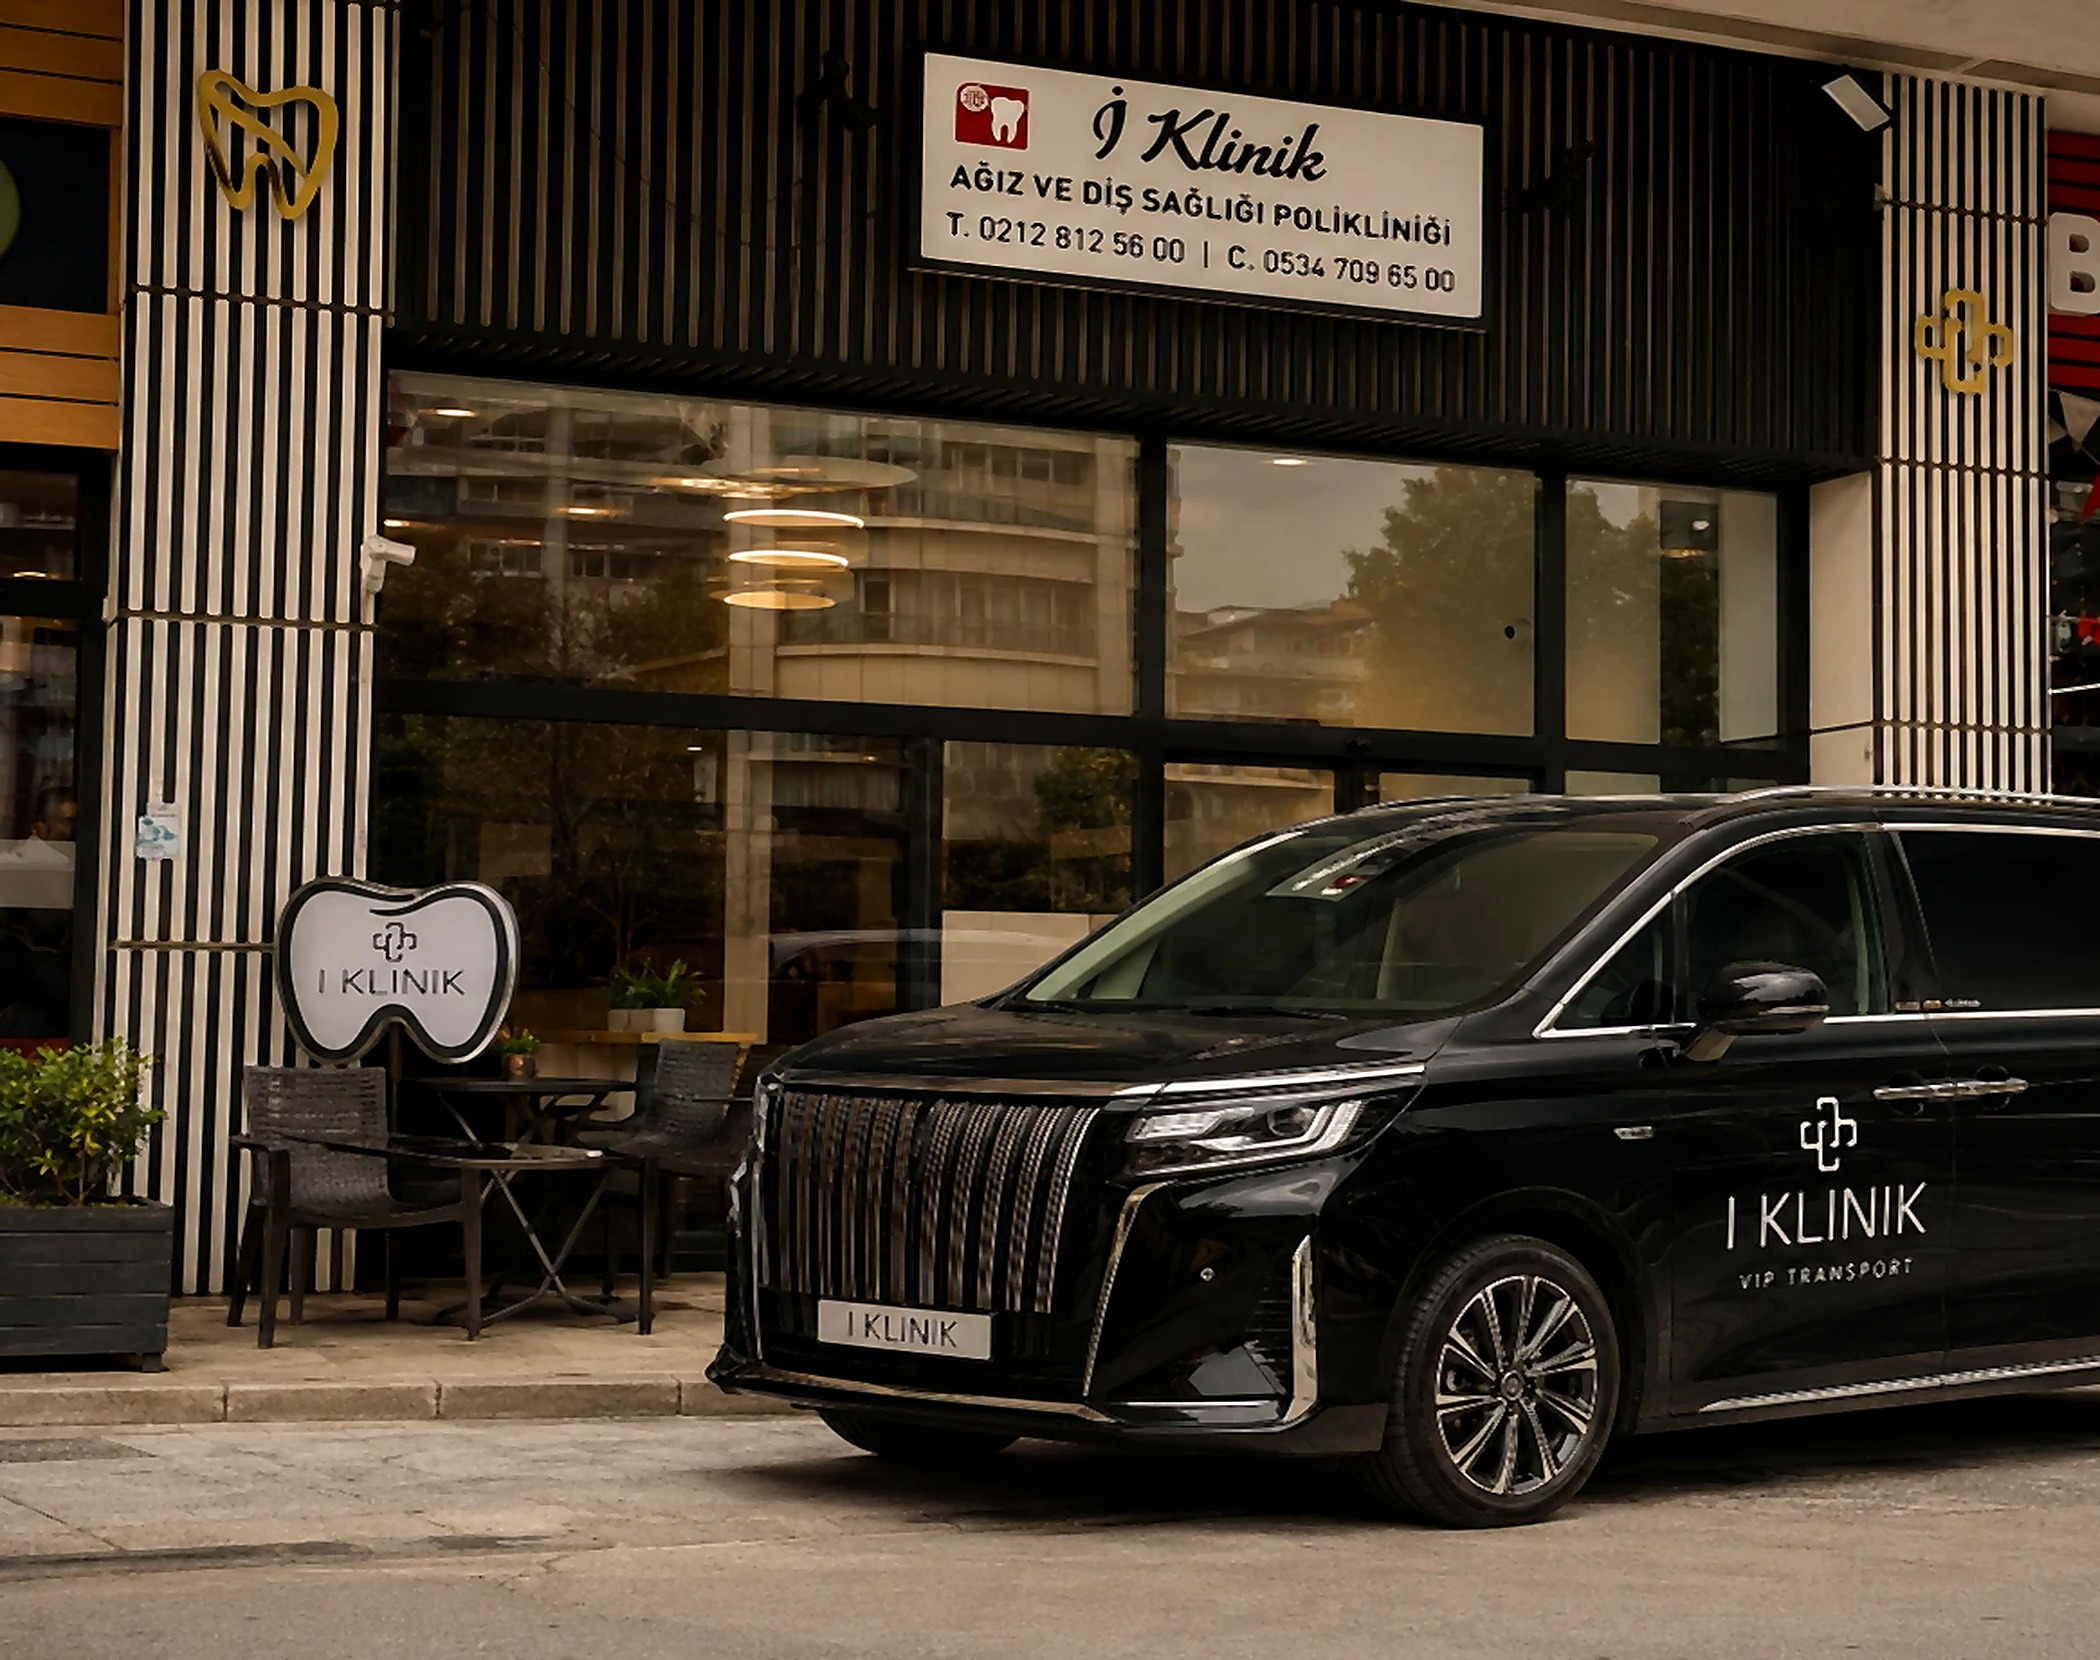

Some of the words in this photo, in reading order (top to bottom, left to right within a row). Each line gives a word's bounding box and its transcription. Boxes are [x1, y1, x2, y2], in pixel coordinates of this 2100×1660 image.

[1140, 109, 1327, 181] Klinik
[950, 160, 1025, 196] AĞIZ
[1033, 173, 1073, 202] VE
[1083, 176, 1133, 216] DİŞ
[1142, 187, 1264, 225] SAĞLIĞI
[1274, 203, 1450, 247] POLİKLİNİĞİ
[946, 211, 970, 237] T.
[980, 216, 1047, 247] 0212
[1055, 226, 1104, 254] 812
[1113, 232, 1145, 259] 56
[1153, 236, 1186, 264] 00
[1227, 244, 1255, 271] C.
[1263, 249, 1325, 278] 0534
[1334, 257, 1380, 285] 709
[1388, 263, 1418, 290] 65
[1425, 267, 1456, 294] 00
[318, 968, 325, 994] I
[342, 968, 465, 996] KLINIK
[1727, 1195, 1736, 1250] I
[1759, 1181, 1928, 1248] KLINIK
[1739, 1270, 1775, 1290] VIP
[1786, 1256, 1914, 1286] TRANSPORT
[864, 1312, 958, 1348] KLINIK
